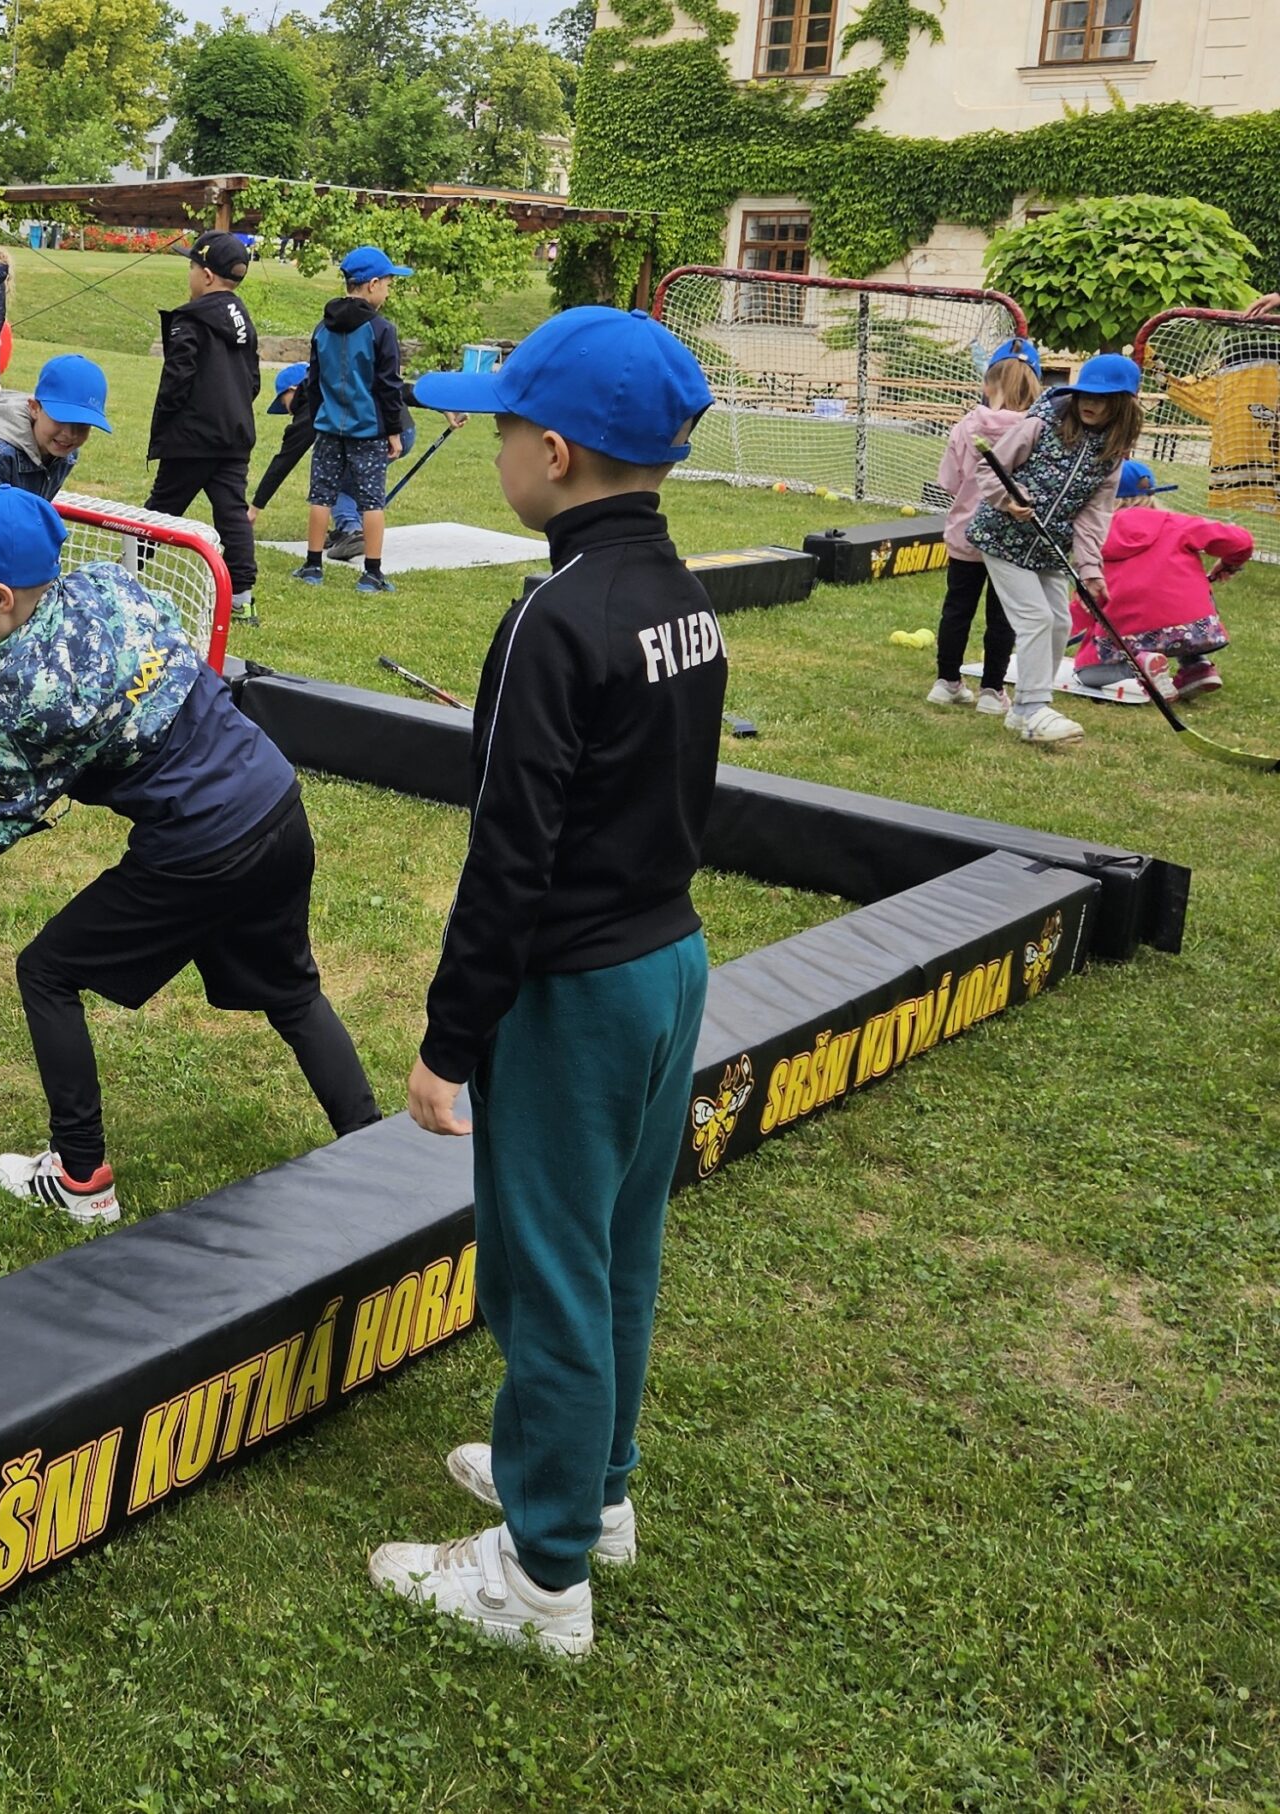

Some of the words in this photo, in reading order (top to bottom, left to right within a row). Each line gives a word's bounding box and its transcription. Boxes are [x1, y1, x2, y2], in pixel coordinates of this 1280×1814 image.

[227, 303, 247, 344] NEW
[101, 519, 152, 538] WINNWELL
[892, 540, 931, 576] SRŠNI
[638, 622, 679, 683] FK
[677, 609, 728, 669] LED
[759, 1030, 861, 1136] SRŠNI
[854, 971, 952, 1088] KUTNÁ
[943, 950, 1014, 1039] HORA
[126, 1296, 344, 1516] KUTNÁ
[341, 1241, 478, 1394] HORA
